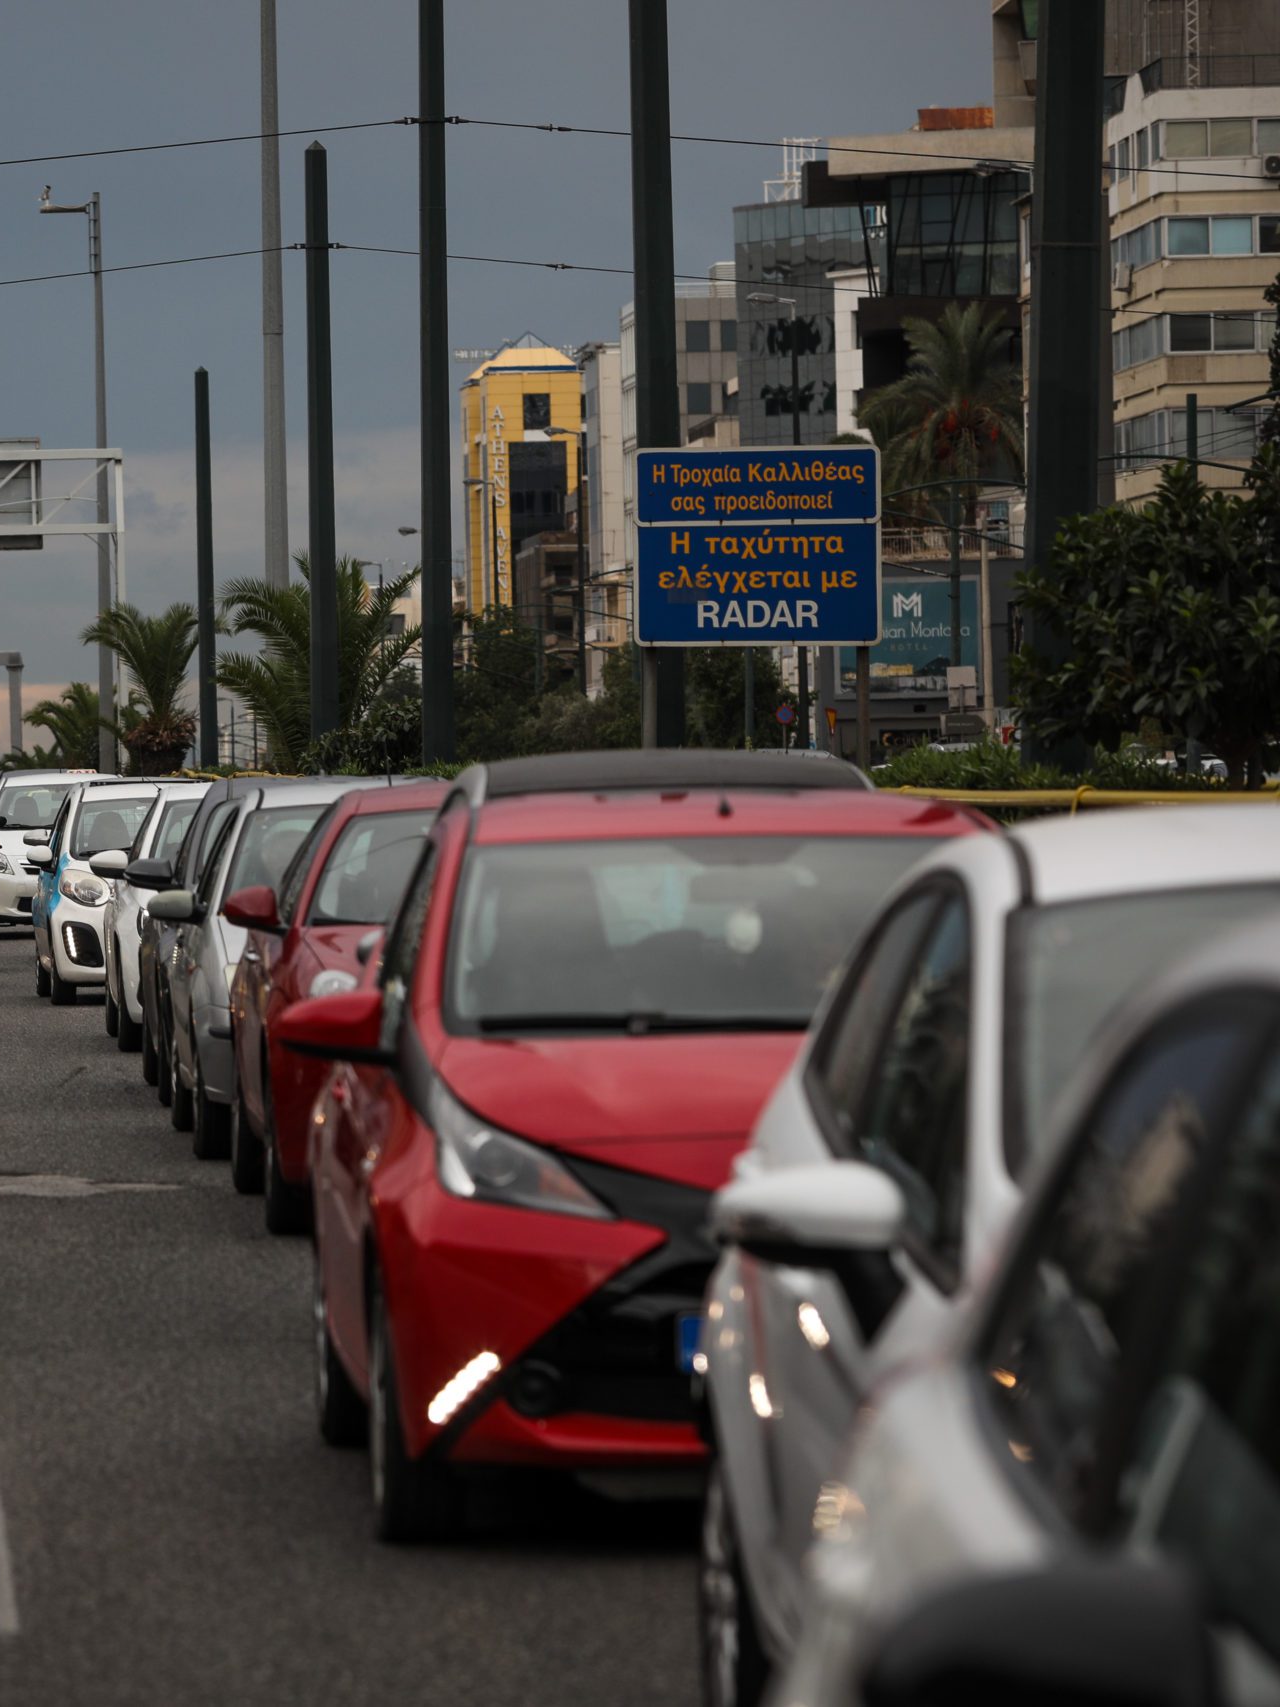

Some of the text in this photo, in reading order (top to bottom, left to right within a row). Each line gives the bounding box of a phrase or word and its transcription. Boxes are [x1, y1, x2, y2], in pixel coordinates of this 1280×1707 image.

[490, 405, 506, 507] ATHENS
[653, 460, 864, 487] Η Τροχαία Καλλιθέας
[671, 490, 833, 515] σας προειδοποιεί
[671, 528, 844, 559] Η ταχύτητα
[658, 564, 858, 593] ελέγχεται με
[697, 599, 819, 628] RADAR
